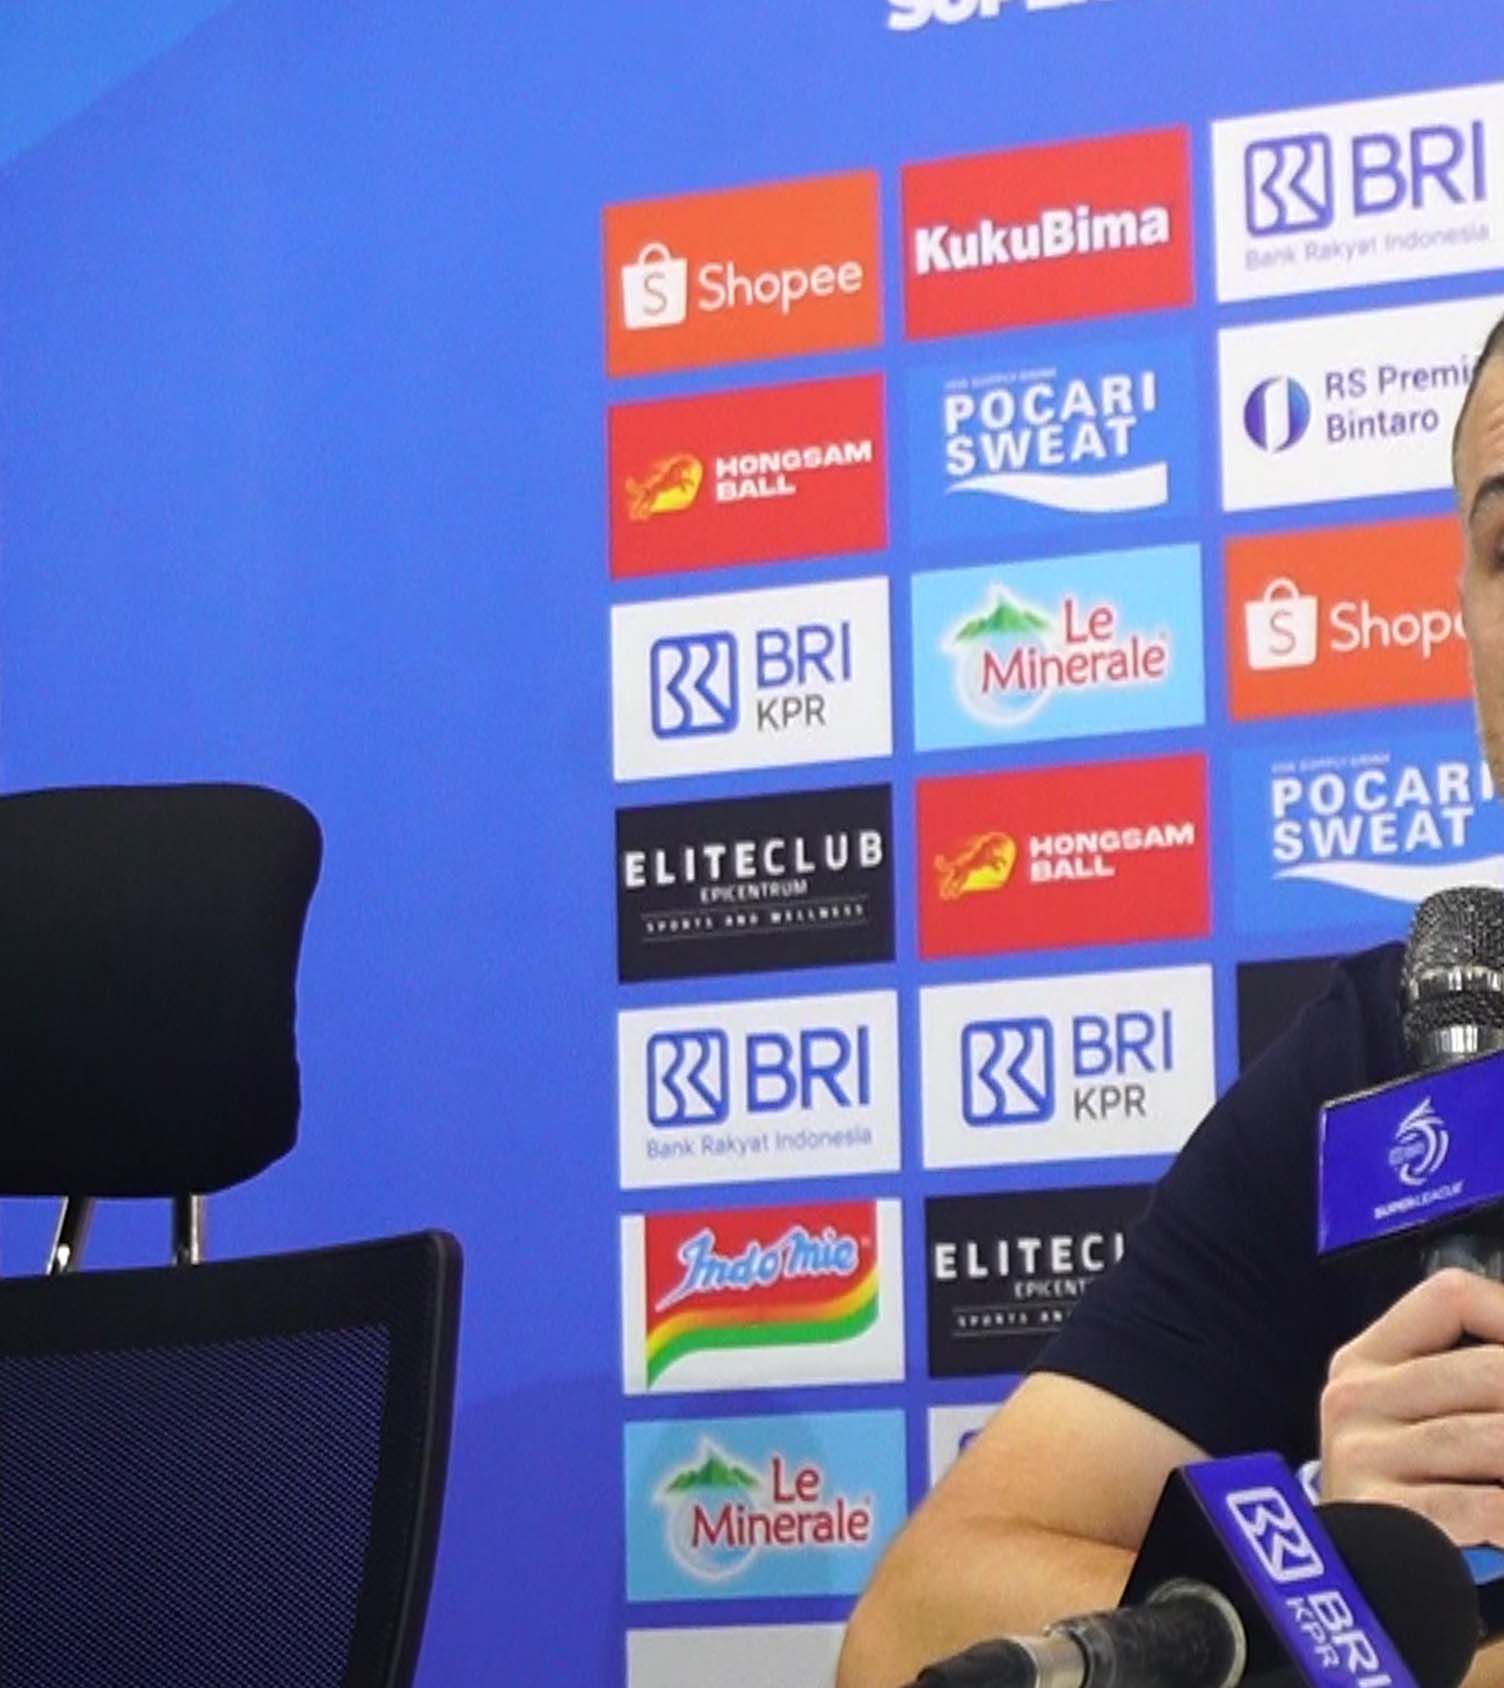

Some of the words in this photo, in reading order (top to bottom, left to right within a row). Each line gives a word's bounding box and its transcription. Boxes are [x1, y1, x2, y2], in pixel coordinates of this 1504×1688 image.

[1351, 119, 1487, 218] BRI
[914, 206, 1170, 277] KukuBima
[1245, 247, 1296, 271] Bank
[1304, 236, 1378, 262] Rakyat
[1384, 222, 1490, 250] Indonesia
[698, 260, 864, 317] Shopee
[945, 369, 1156, 435] POCARI
[1325, 367, 1367, 401] RS
[1379, 354, 1470, 395] Premi
[946, 414, 1137, 477] SWEAT
[1326, 407, 1440, 444] Bintaro
[715, 439, 873, 480] HONGSAM
[716, 474, 797, 503] BALL
[1064, 598, 1114, 644] Le
[1329, 598, 1468, 660] Shop
[755, 620, 852, 689] BRI
[981, 635, 1165, 694] Minerale
[757, 693, 827, 732] KPR
[1271, 759, 1495, 819] POCARI
[624, 829, 883, 888] ELITECLUB
[1029, 821, 1196, 858] HONGSAM
[1272, 806, 1475, 863] SWEAT
[700, 878, 808, 904] EPICENTRUM
[1030, 856, 1116, 884] BALL
[745, 1024, 871, 1114] BRI
[1072, 1009, 1173, 1078] BRI
[1074, 1083, 1147, 1121] KPR
[647, 1137, 695, 1159] Bank
[702, 1133, 769, 1157] Rakyat
[776, 1125, 872, 1148] Indonesia
[933, 1232, 1124, 1280] ELITEC
[1014, 1276, 1095, 1299] EPICENT
[772, 1456, 820, 1504] Le
[690, 1498, 870, 1549] Minerale
[1285, 1596, 1340, 1669] KPR
[1305, 1589, 1393, 1688] BRI
